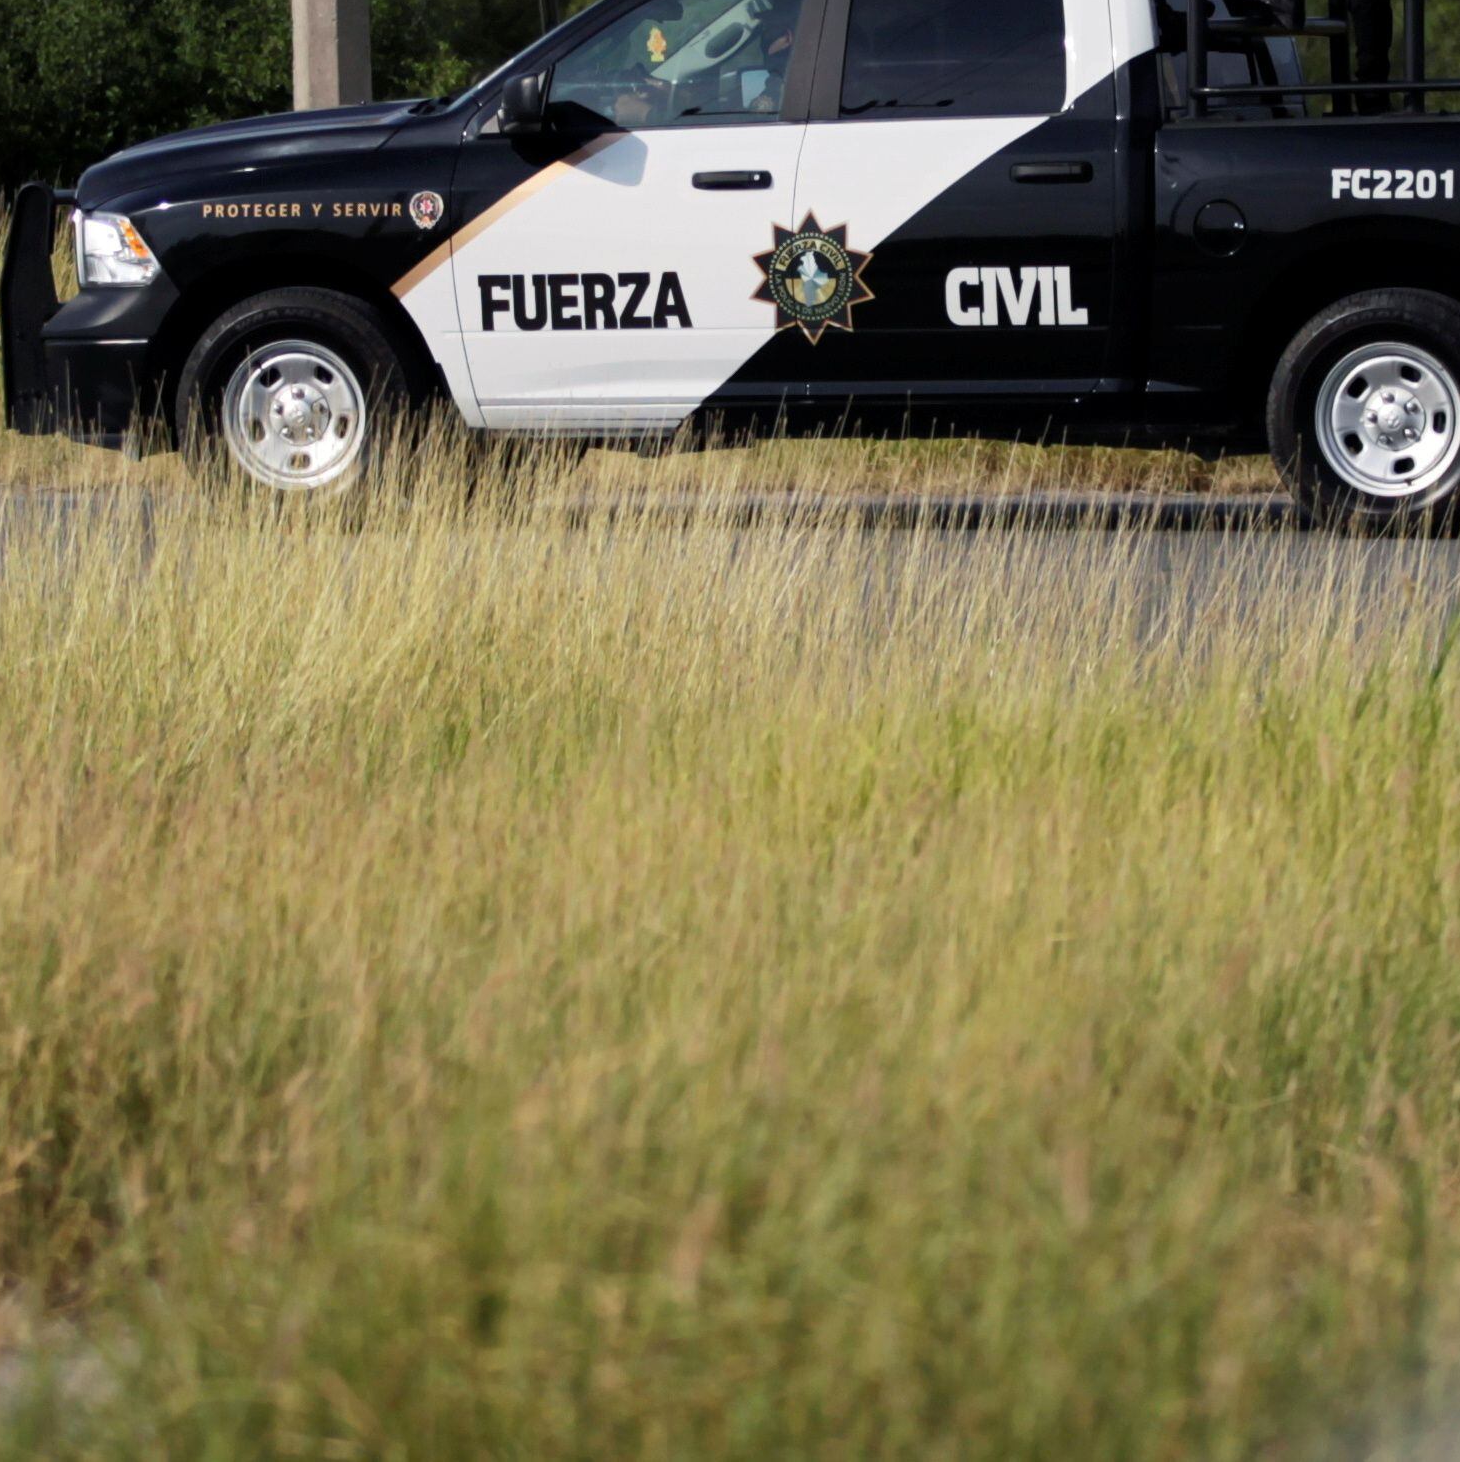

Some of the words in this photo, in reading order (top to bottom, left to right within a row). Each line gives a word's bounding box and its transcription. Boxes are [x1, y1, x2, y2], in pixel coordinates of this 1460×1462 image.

[1331, 168, 1454, 199] FC2201
[202, 202, 301, 219] PROTEGER
[312, 202, 323, 218] Y
[333, 202, 402, 218] SERVIR
[778, 240, 817, 267] FUERZA
[819, 242, 843, 268] CIVIL
[477, 271, 694, 332] FUERZA
[945, 265, 1089, 326] CIVIL
